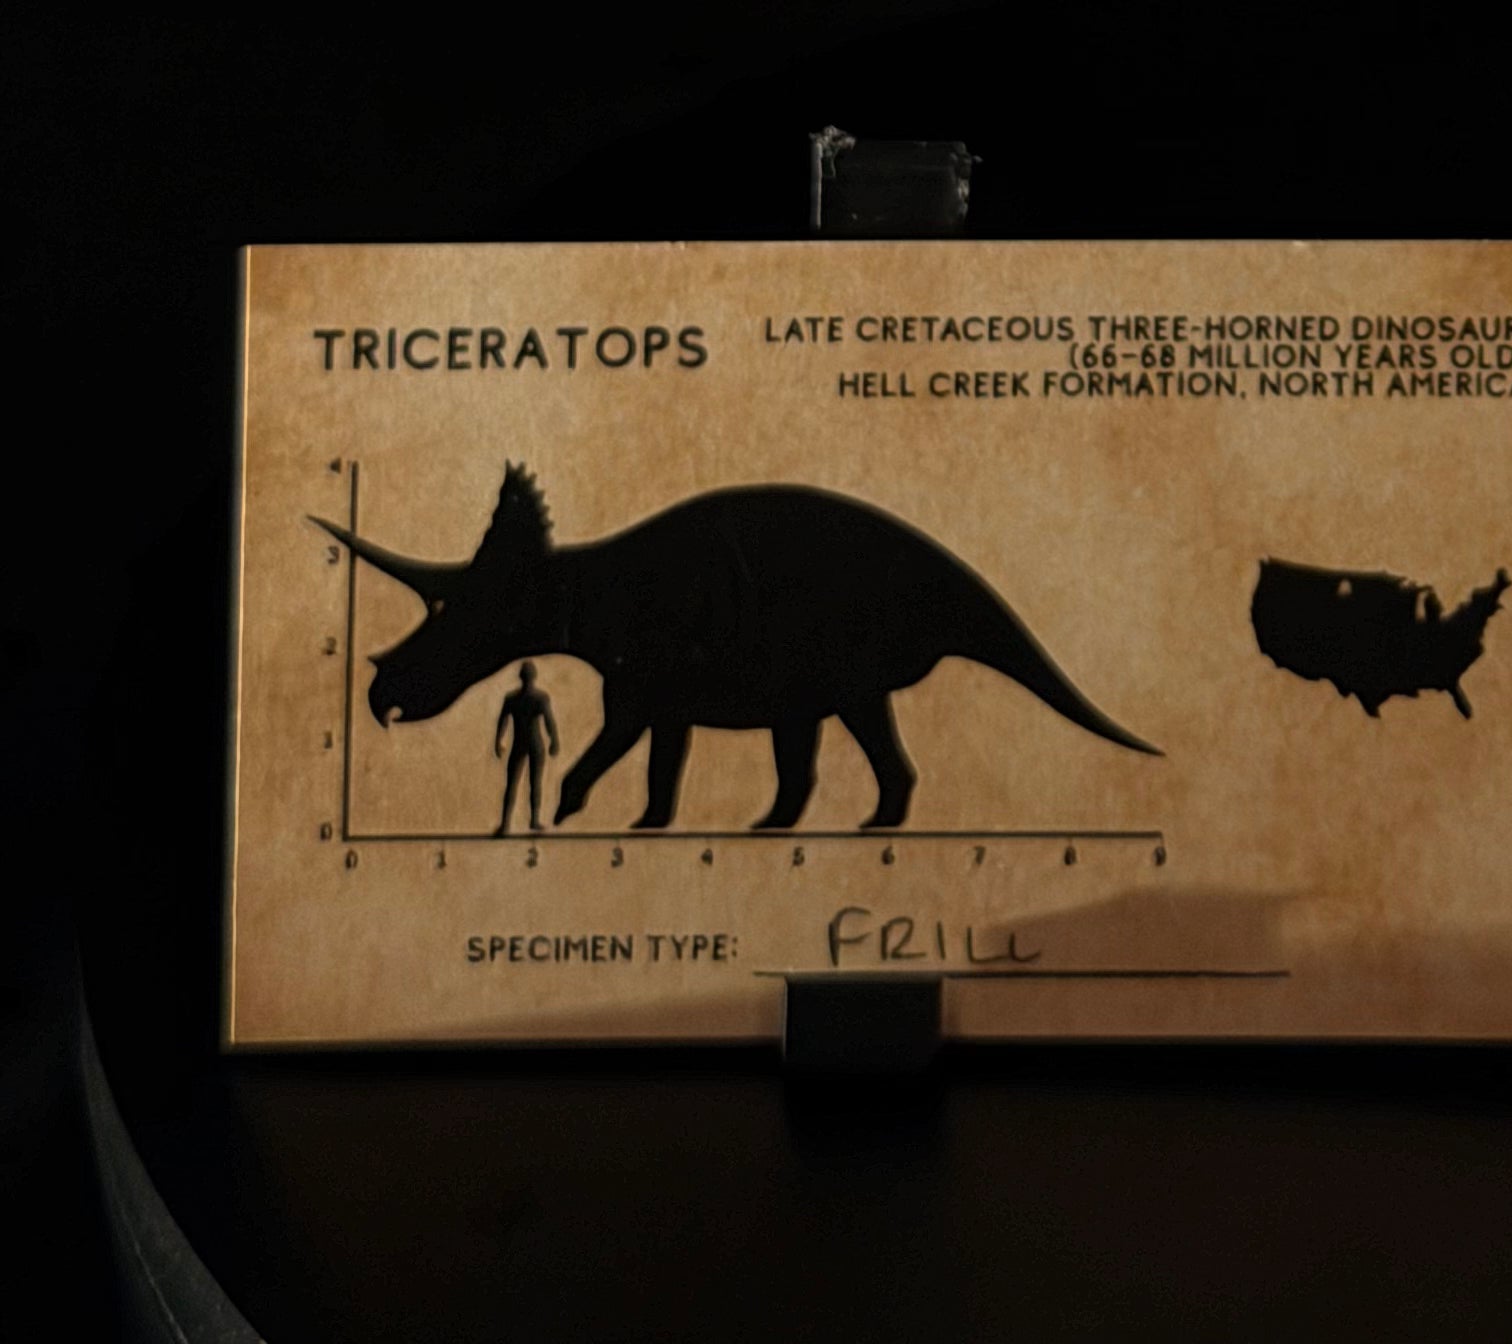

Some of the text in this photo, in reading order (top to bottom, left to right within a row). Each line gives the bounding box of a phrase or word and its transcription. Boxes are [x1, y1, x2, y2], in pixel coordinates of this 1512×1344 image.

[765, 316, 844, 343] LATE
[856, 316, 1075, 343] CRETACEOUS
[1088, 316, 1341, 342] THREE-HORNED
[313, 326, 709, 370] TRICERATOPS
[1189, 344, 1322, 369] MILLION
[1335, 344, 1438, 369] YEARS
[838, 372, 916, 399] HELL
[928, 372, 1031, 399] CREEK
[1042, 372, 1247, 400] FORMATION,
[1259, 372, 1374, 398] NORTH
[466, 933, 739, 964] SPECIMEN TYPE:
[827, 906, 1042, 967] FRILL
